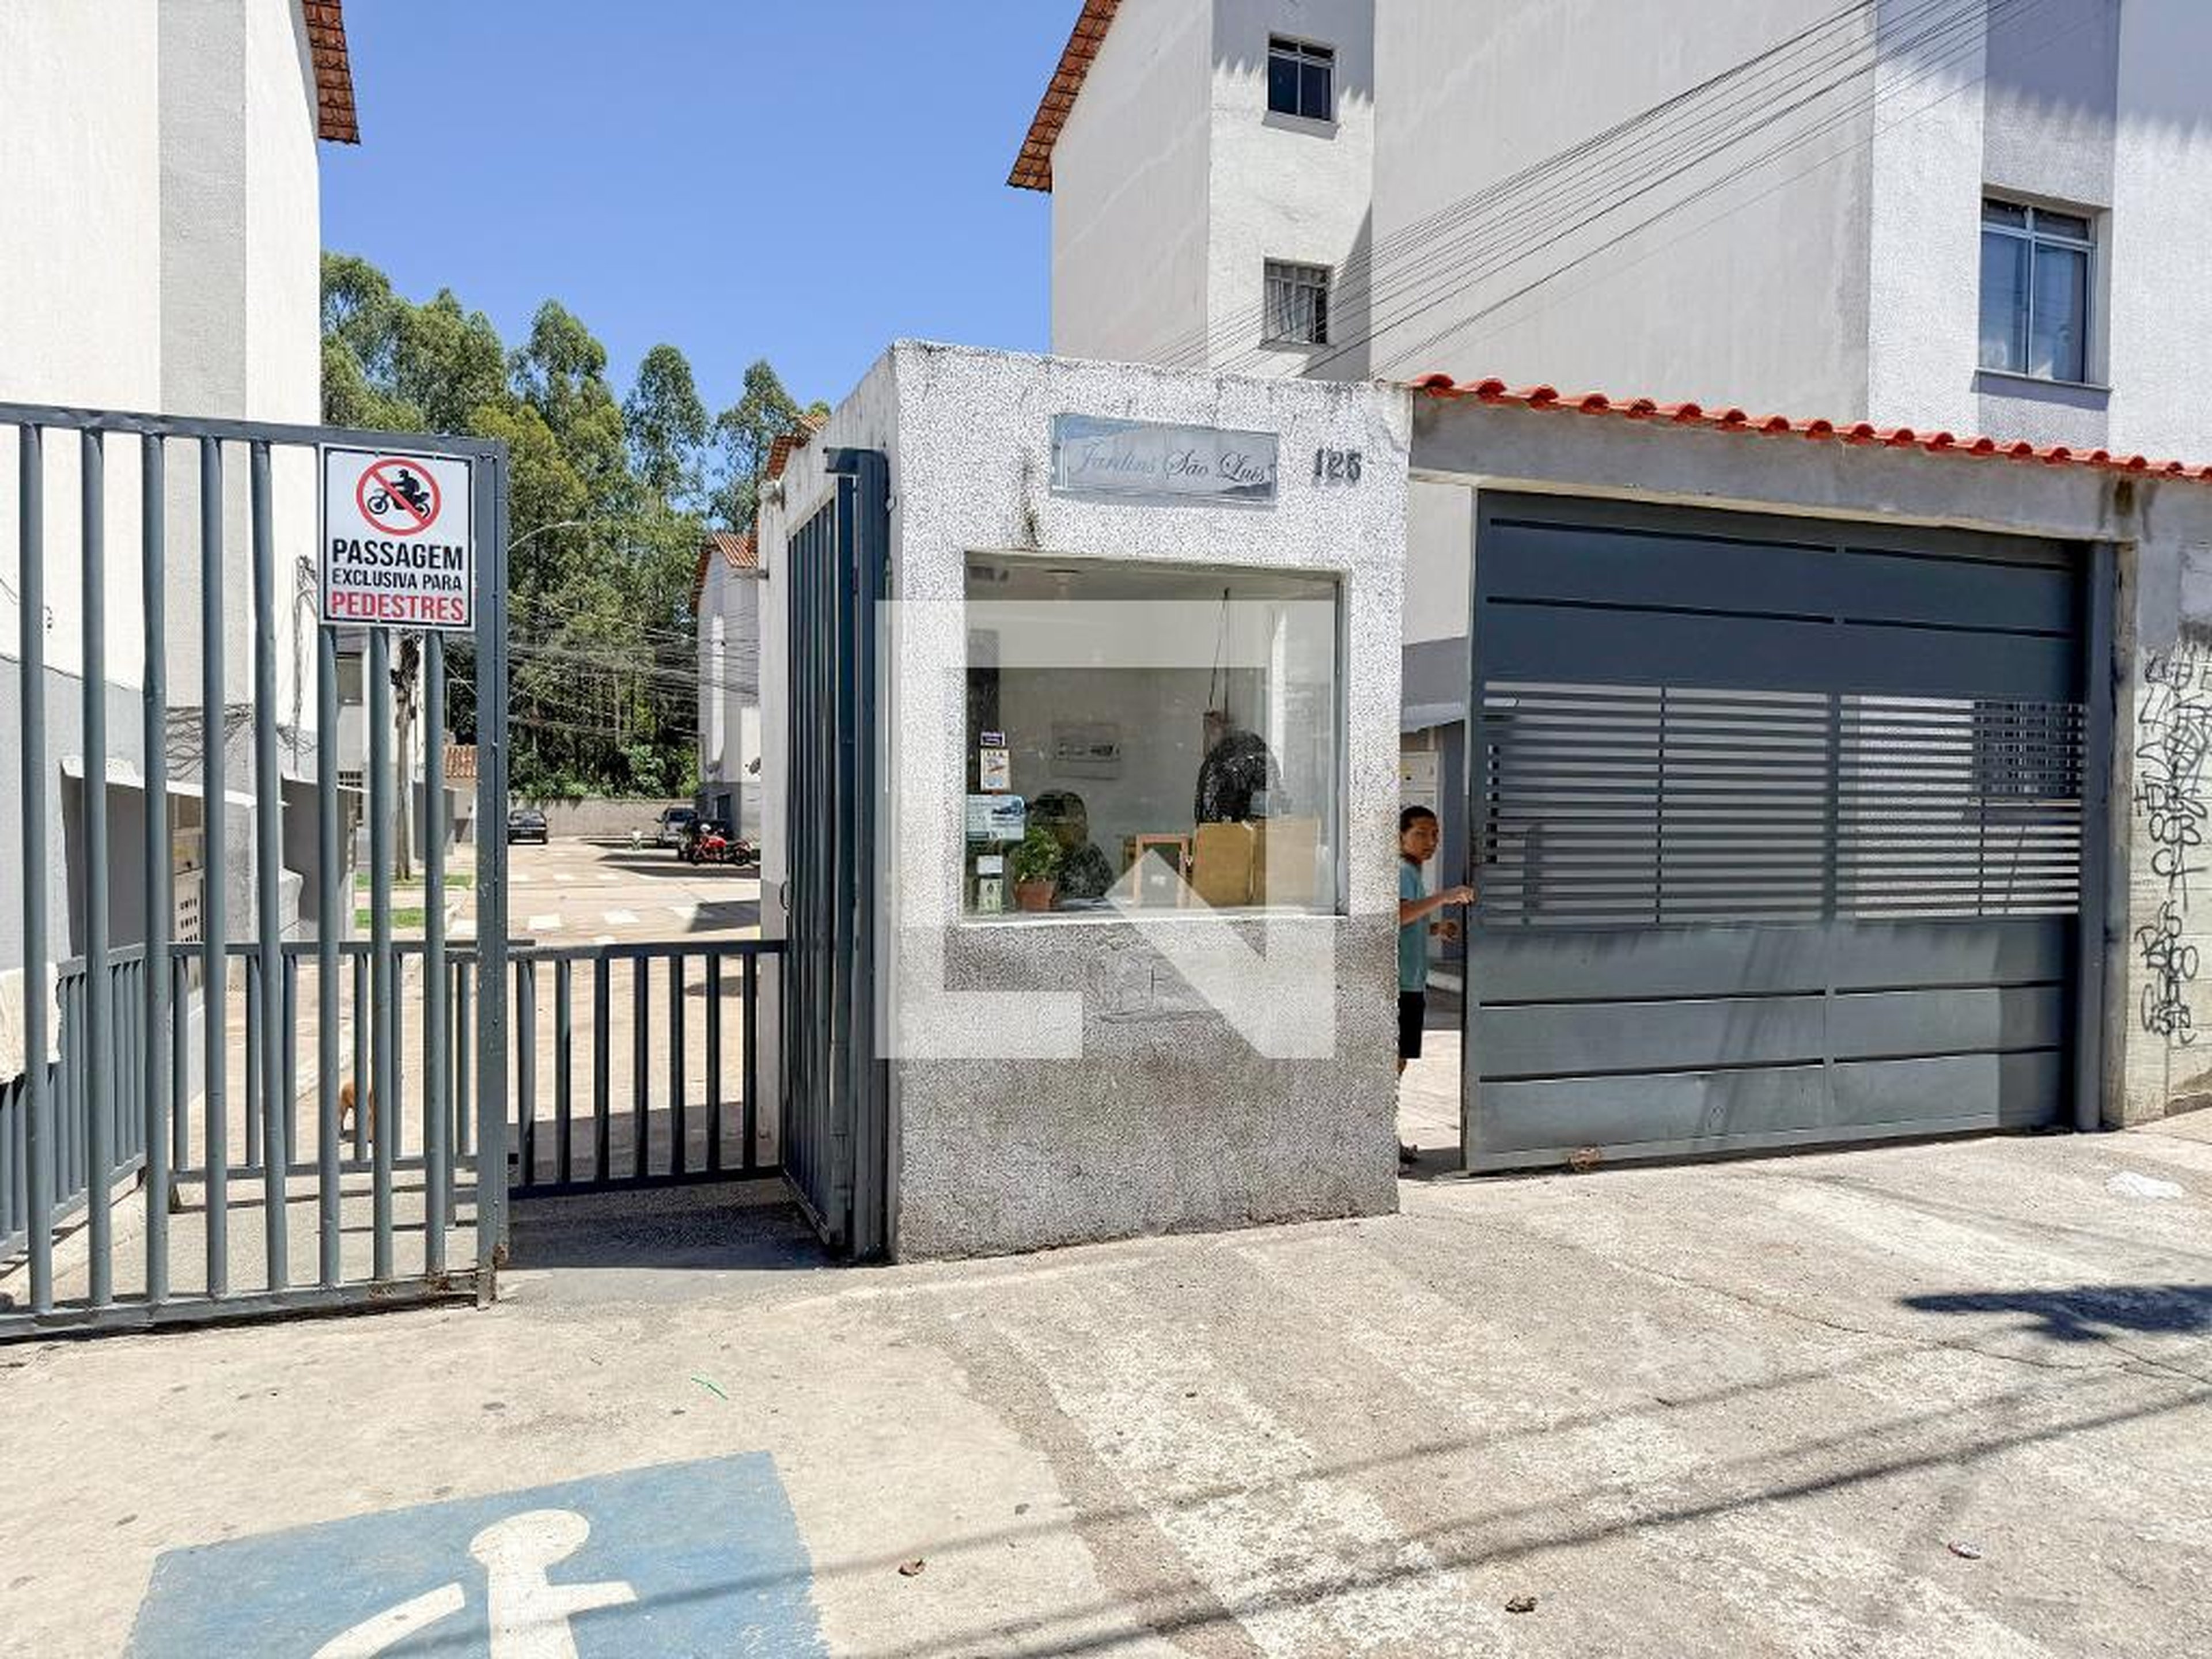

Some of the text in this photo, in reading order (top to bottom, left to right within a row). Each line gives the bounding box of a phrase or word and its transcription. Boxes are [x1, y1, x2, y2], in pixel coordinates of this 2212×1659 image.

[1163, 449, 1209, 480] São
[332, 538, 463, 571] PASSAGEM
[332, 567, 463, 591] EXCLUSIVA PARA
[331, 591, 464, 621] PEDESTRES
